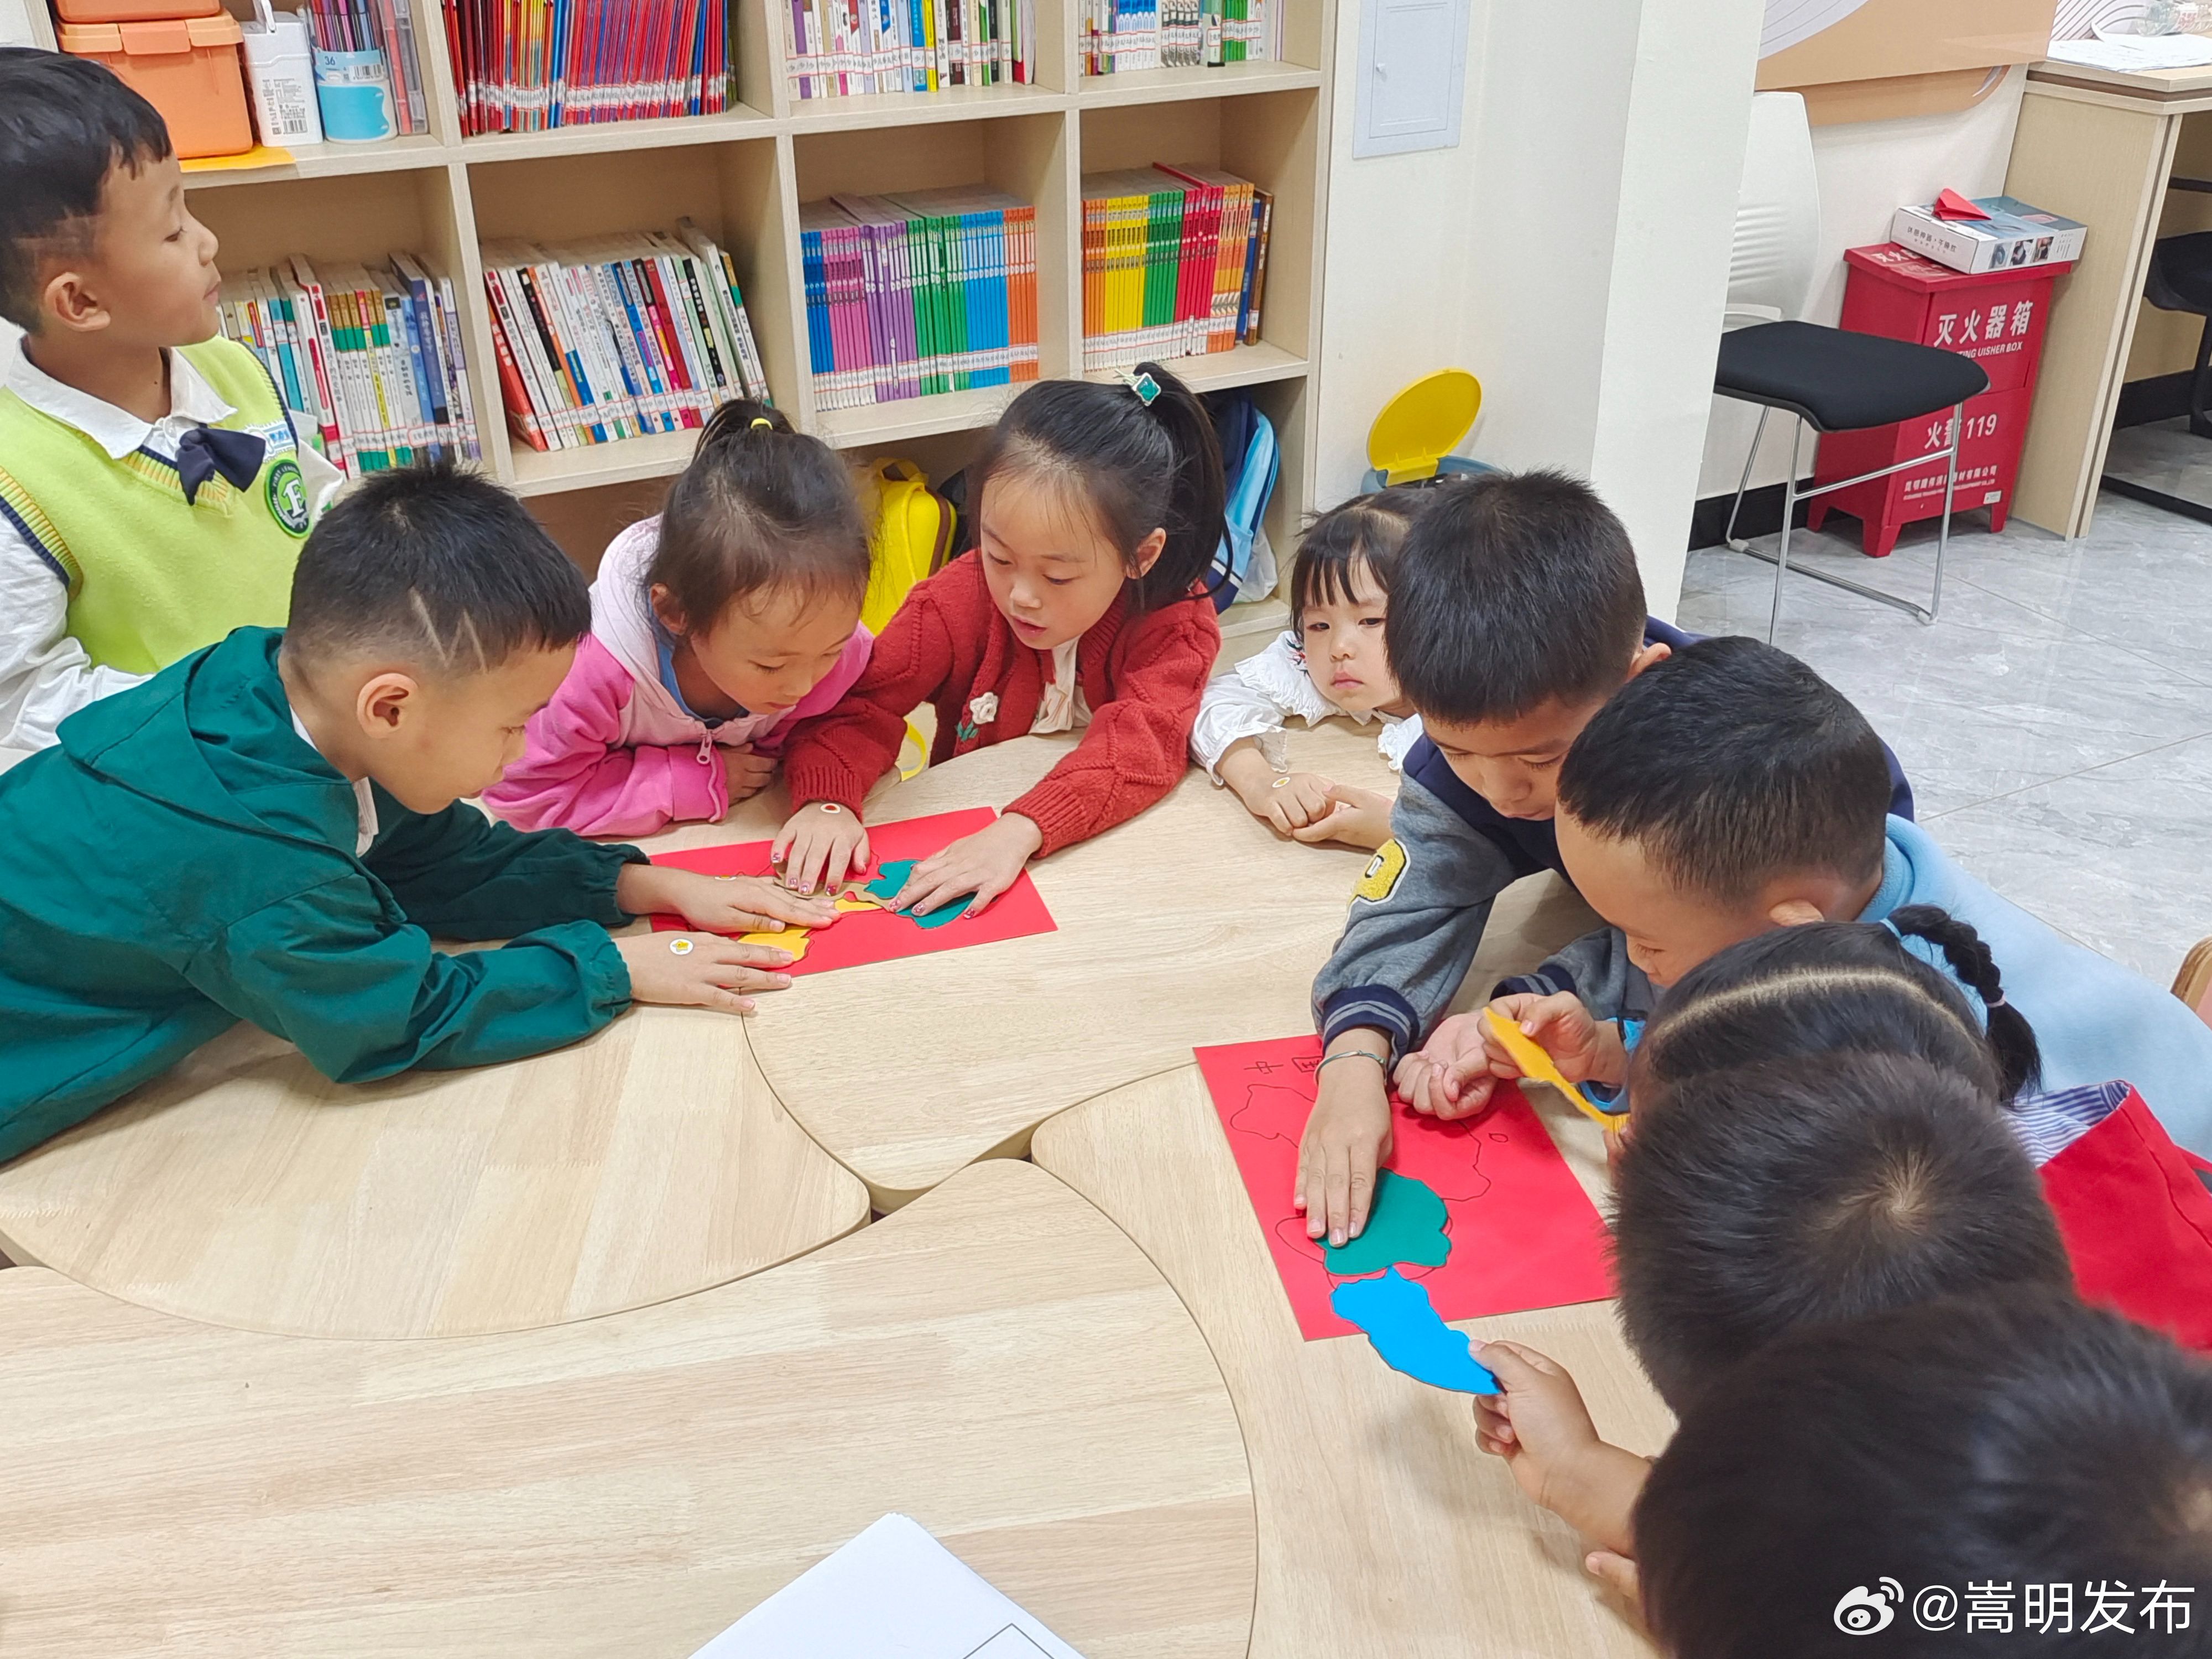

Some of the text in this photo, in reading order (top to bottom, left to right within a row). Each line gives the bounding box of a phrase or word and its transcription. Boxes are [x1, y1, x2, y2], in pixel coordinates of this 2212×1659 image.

[324, 55, 336, 65] 36
[1933, 299, 2033, 348] 灭火器箱
[2006, 341, 2023, 353] BOX
[1966, 414, 1997, 440] 119
